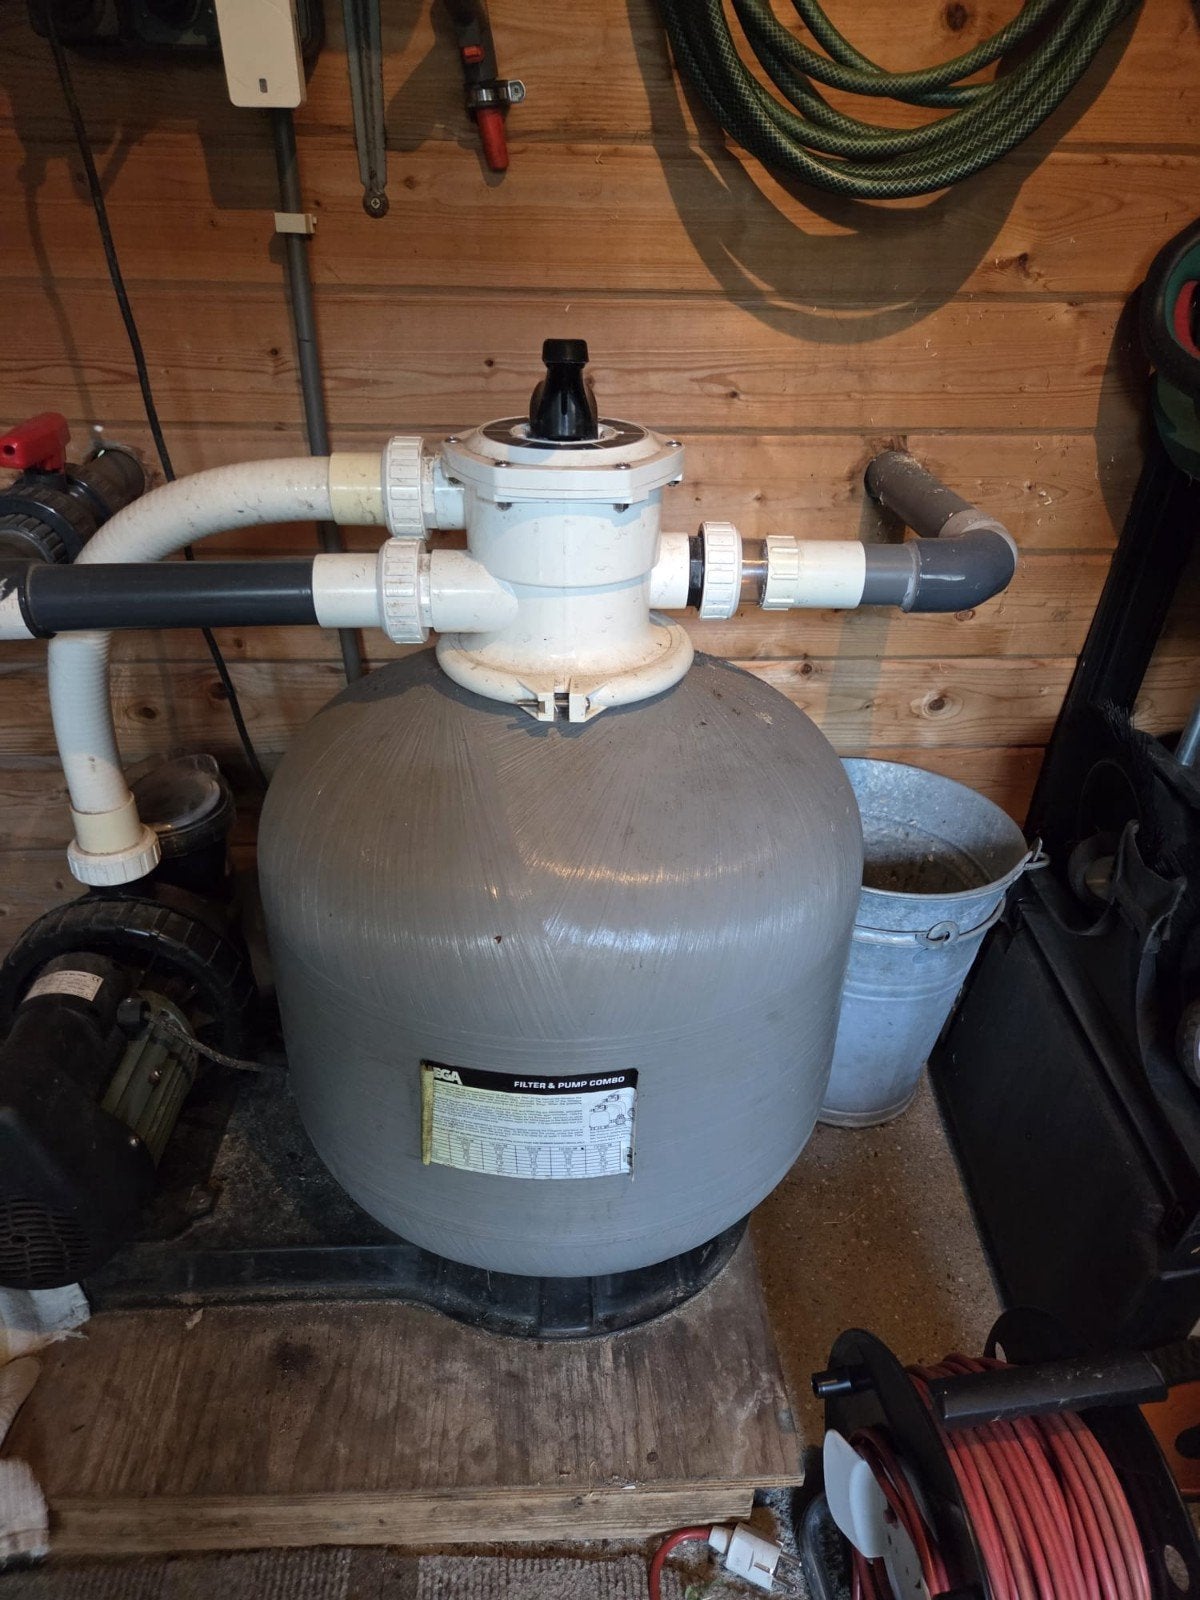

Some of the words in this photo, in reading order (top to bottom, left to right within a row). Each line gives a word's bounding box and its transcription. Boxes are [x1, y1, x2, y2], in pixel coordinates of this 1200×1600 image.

[514, 1081, 546, 1089] FILTER
[557, 1080, 587, 1089] PUMP
[589, 1076, 625, 1086] COMBO
